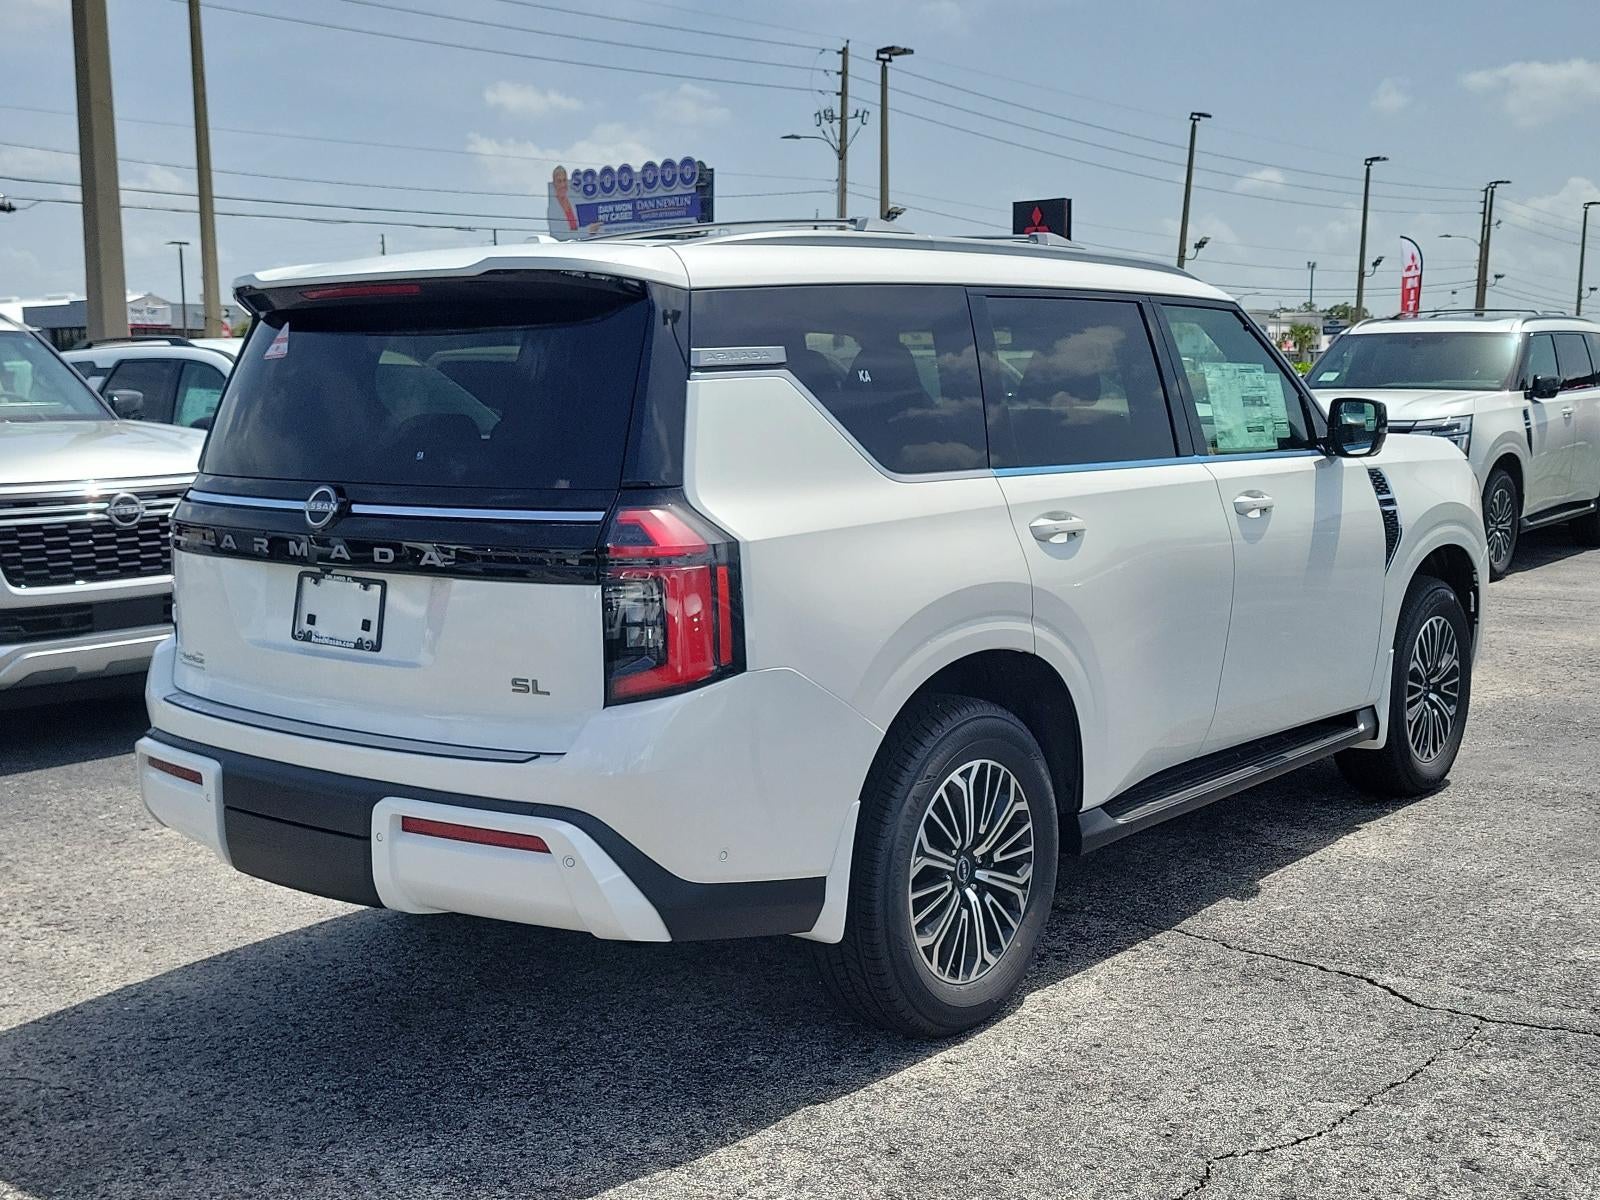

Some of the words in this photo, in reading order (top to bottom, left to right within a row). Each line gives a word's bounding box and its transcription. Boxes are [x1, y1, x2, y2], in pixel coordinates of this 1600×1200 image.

[571, 156, 698, 198] $800,000
[636, 199, 656, 210] DAN
[704, 350, 771, 361] ARMADA
[304, 501, 338, 513] NISSAN
[219, 534, 446, 568] ARMADA
[511, 677, 551, 696] SL
